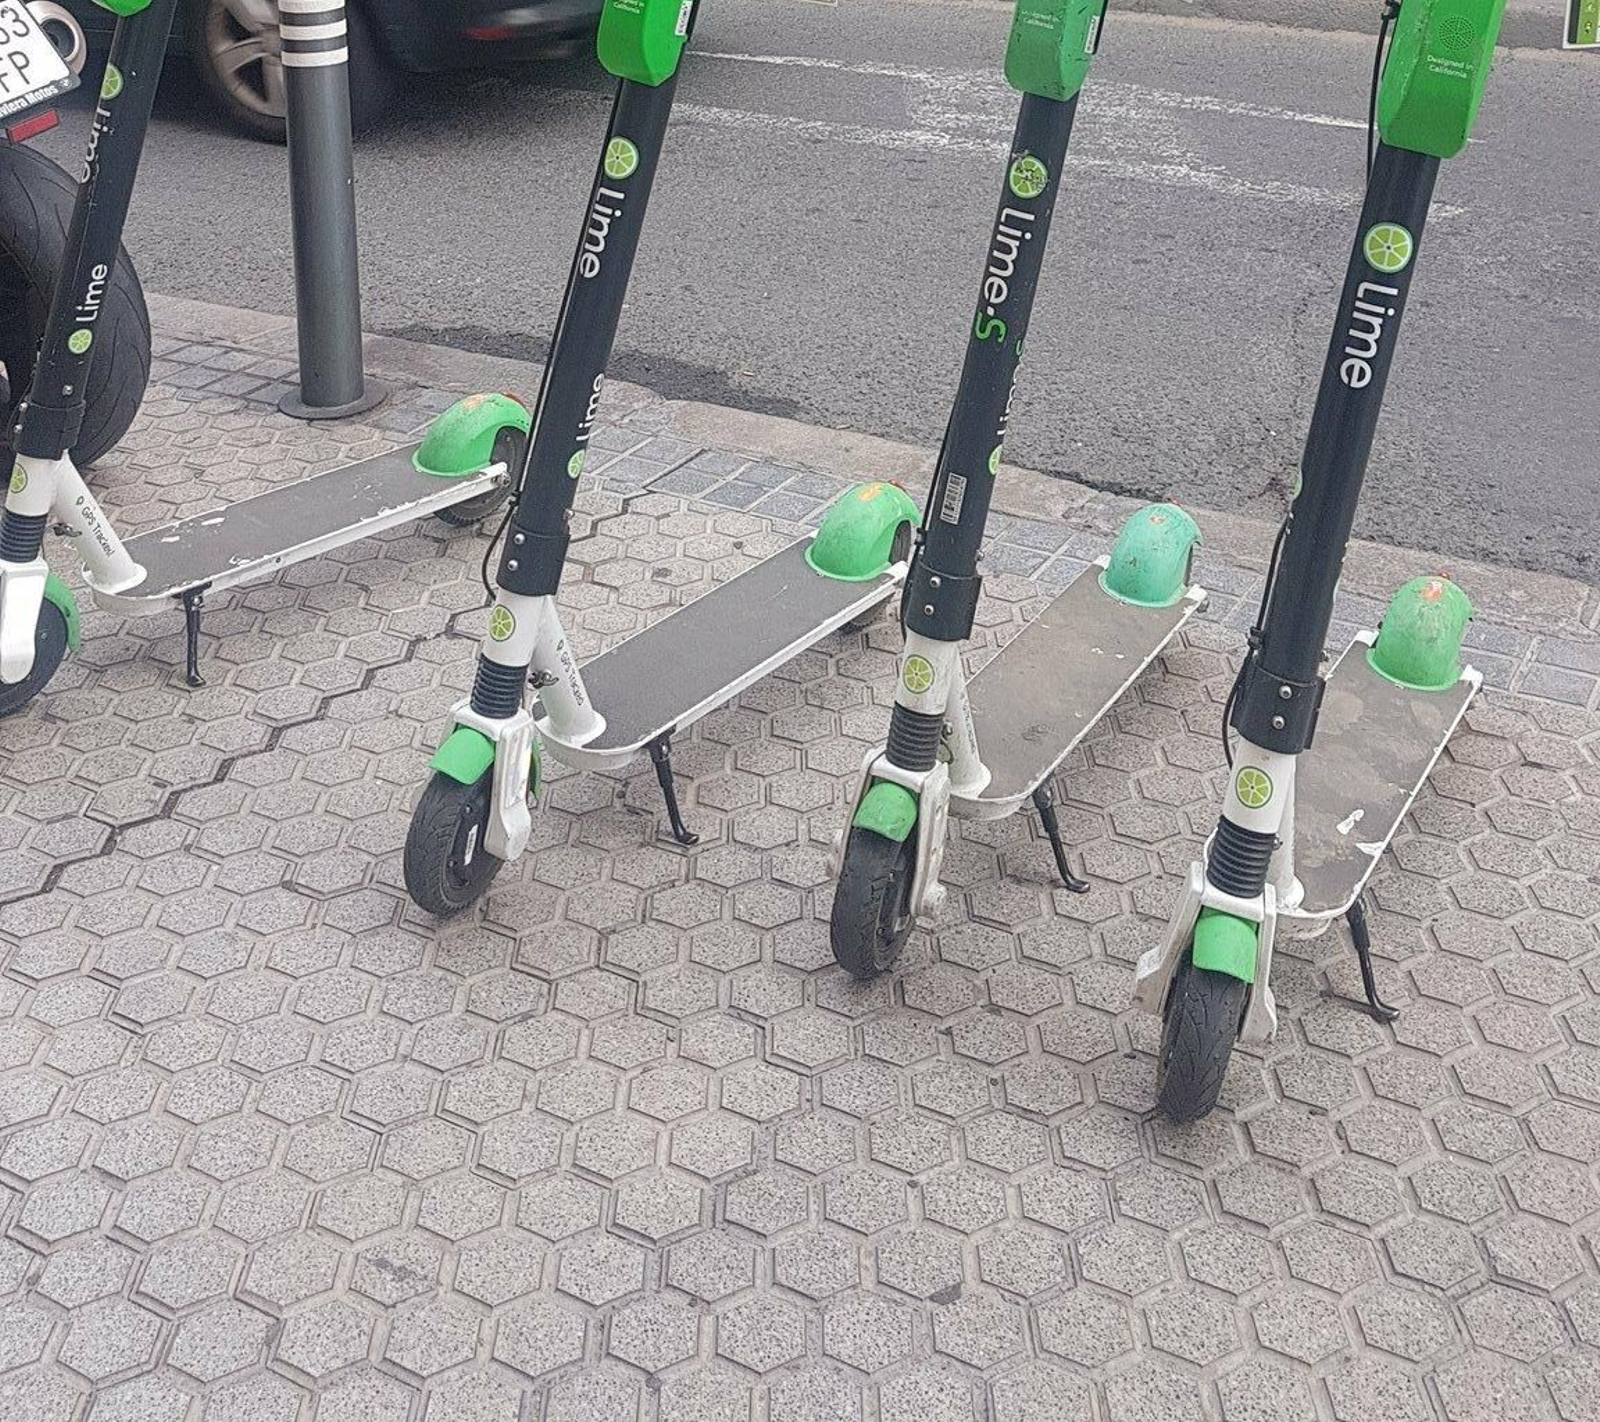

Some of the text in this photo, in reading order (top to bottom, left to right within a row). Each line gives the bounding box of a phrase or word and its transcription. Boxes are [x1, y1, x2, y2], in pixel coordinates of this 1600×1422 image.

[0, 6, 30, 45] 3
[1427, 54, 1465, 69] Designed
[1429, 64, 1467, 79] California
[0, 84, 58, 118] viera Motos
[580, 186, 625, 279] Lime
[76, 263, 108, 322] Lime
[1340, 281, 1399, 389] Lime
[81, 506, 96, 526] GPS
